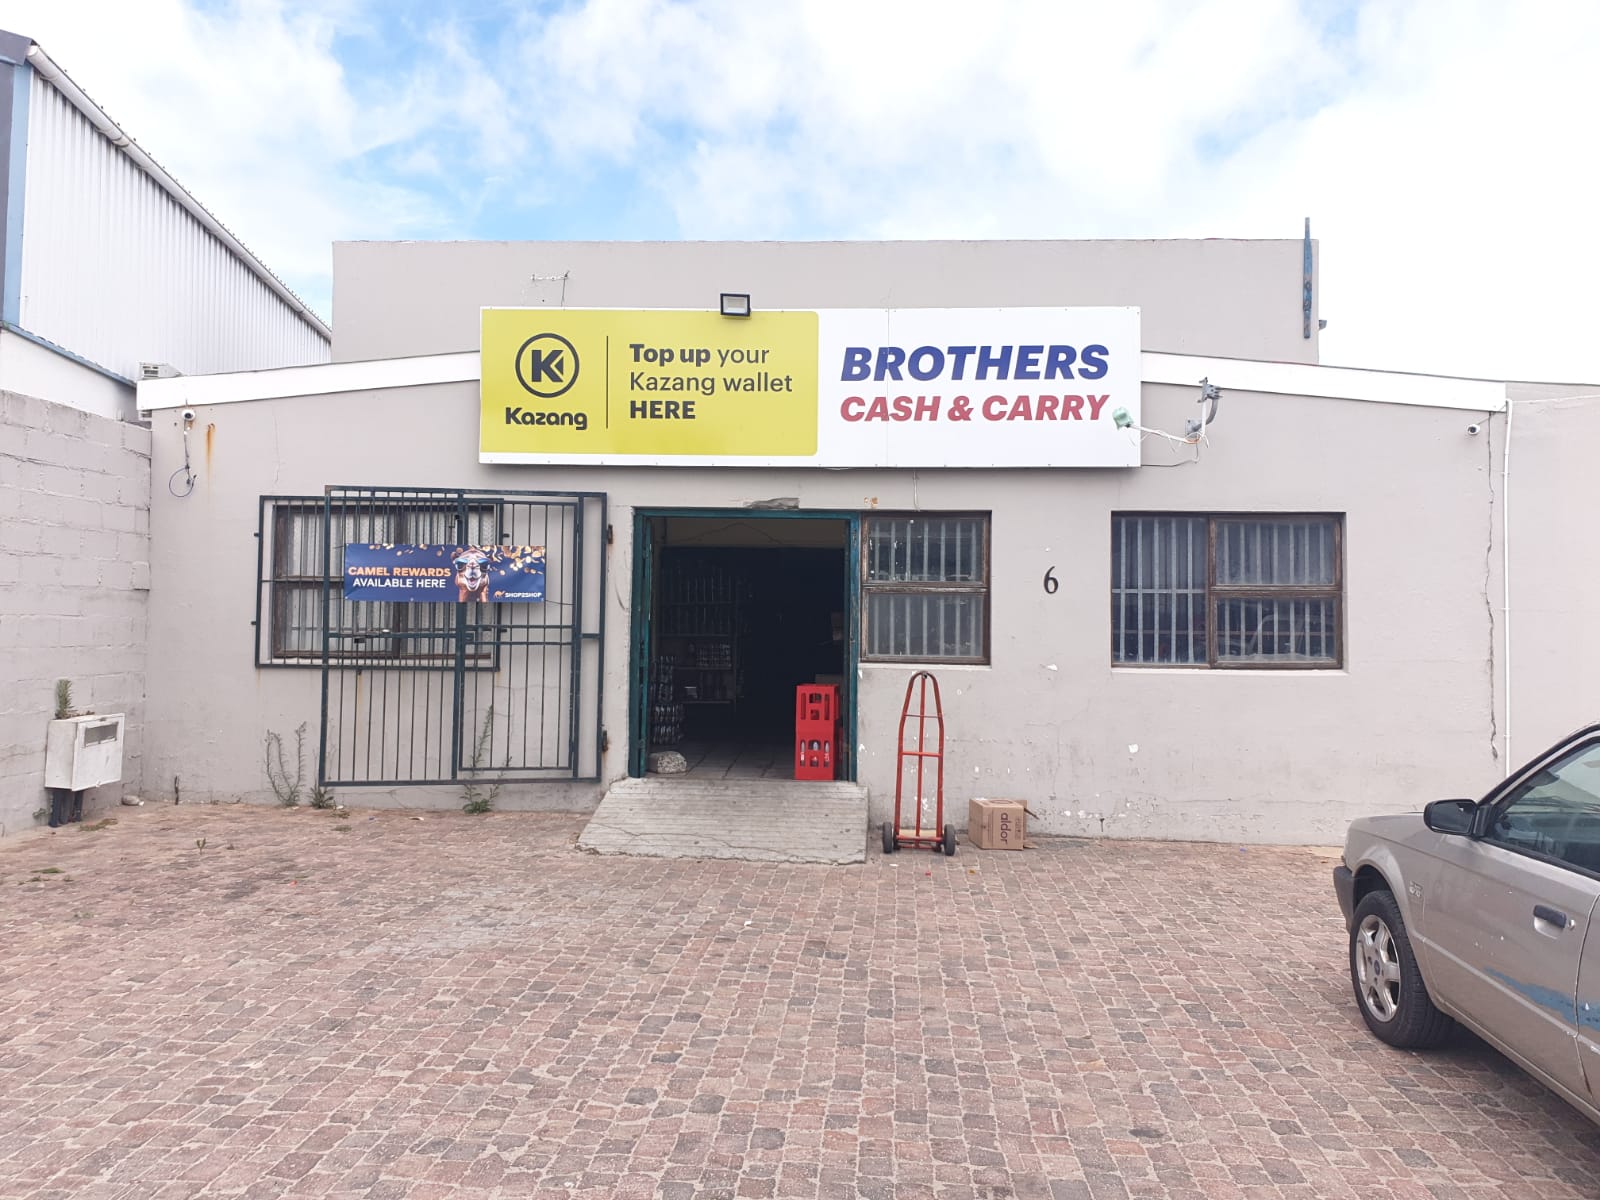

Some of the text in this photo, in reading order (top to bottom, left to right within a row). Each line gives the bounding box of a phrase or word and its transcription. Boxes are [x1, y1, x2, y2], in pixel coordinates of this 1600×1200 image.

[629, 343, 770, 367] Top up your
[840, 344, 1109, 381] BROTHERS
[630, 372, 792, 396] Kazang wallet
[505, 407, 587, 430] Kazang
[629, 400, 696, 420] HERE
[840, 394, 1110, 422] CASH & CARRY
[348, 566, 451, 577] CAMEL REWARDS
[353, 578, 446, 588] AVAILABLE HERE
[1043, 565, 1059, 594] 6
[1000, 812, 1012, 845] aldor
